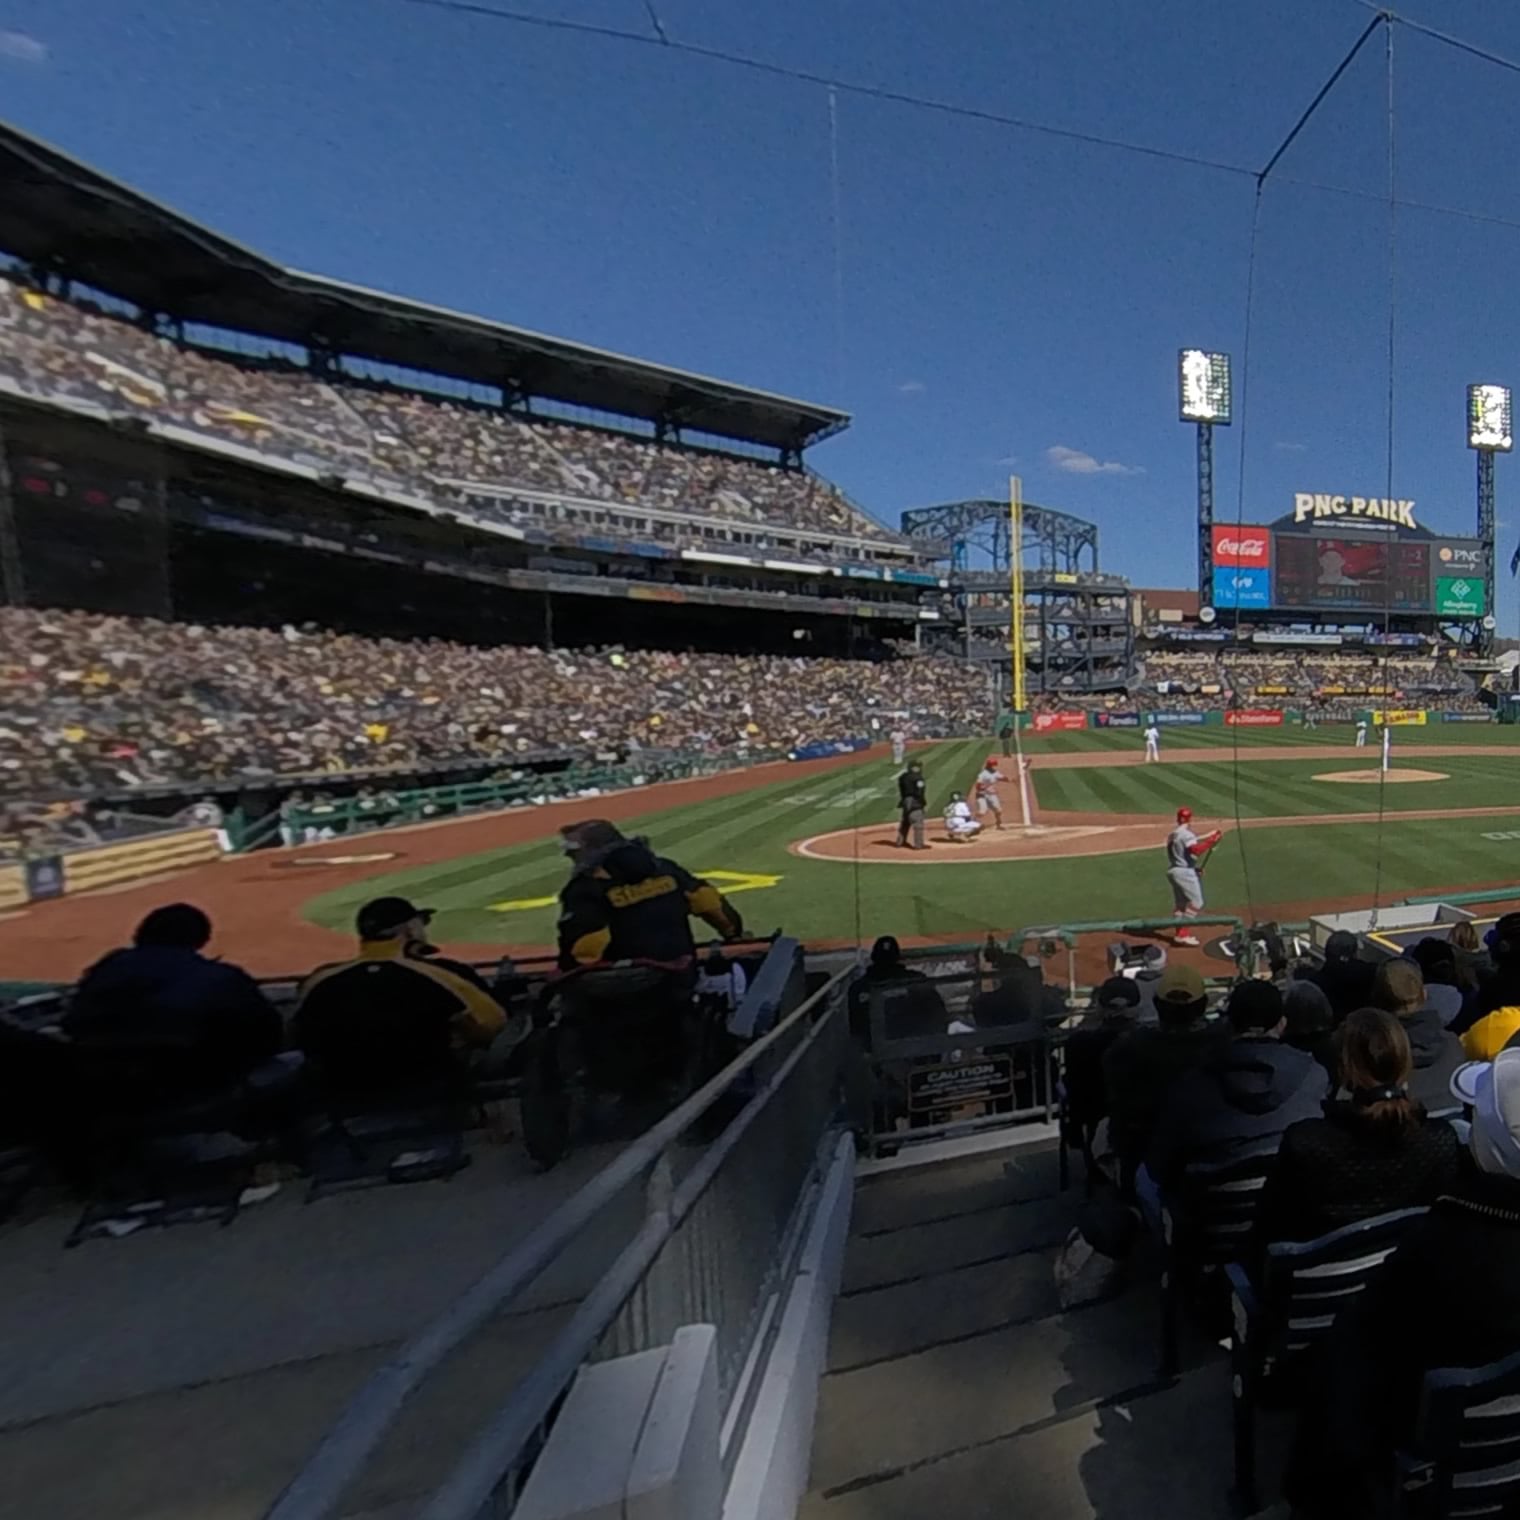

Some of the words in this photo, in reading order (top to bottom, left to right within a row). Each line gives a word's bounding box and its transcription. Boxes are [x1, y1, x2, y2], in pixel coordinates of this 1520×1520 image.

[1295, 493, 1347, 523] PNC
[1352, 497, 1417, 530] PARK
[1216, 538, 1265, 556] Coca-Cola
[1454, 550, 1481, 562] PNC
[926, 1064, 995, 1082] CAUTION
